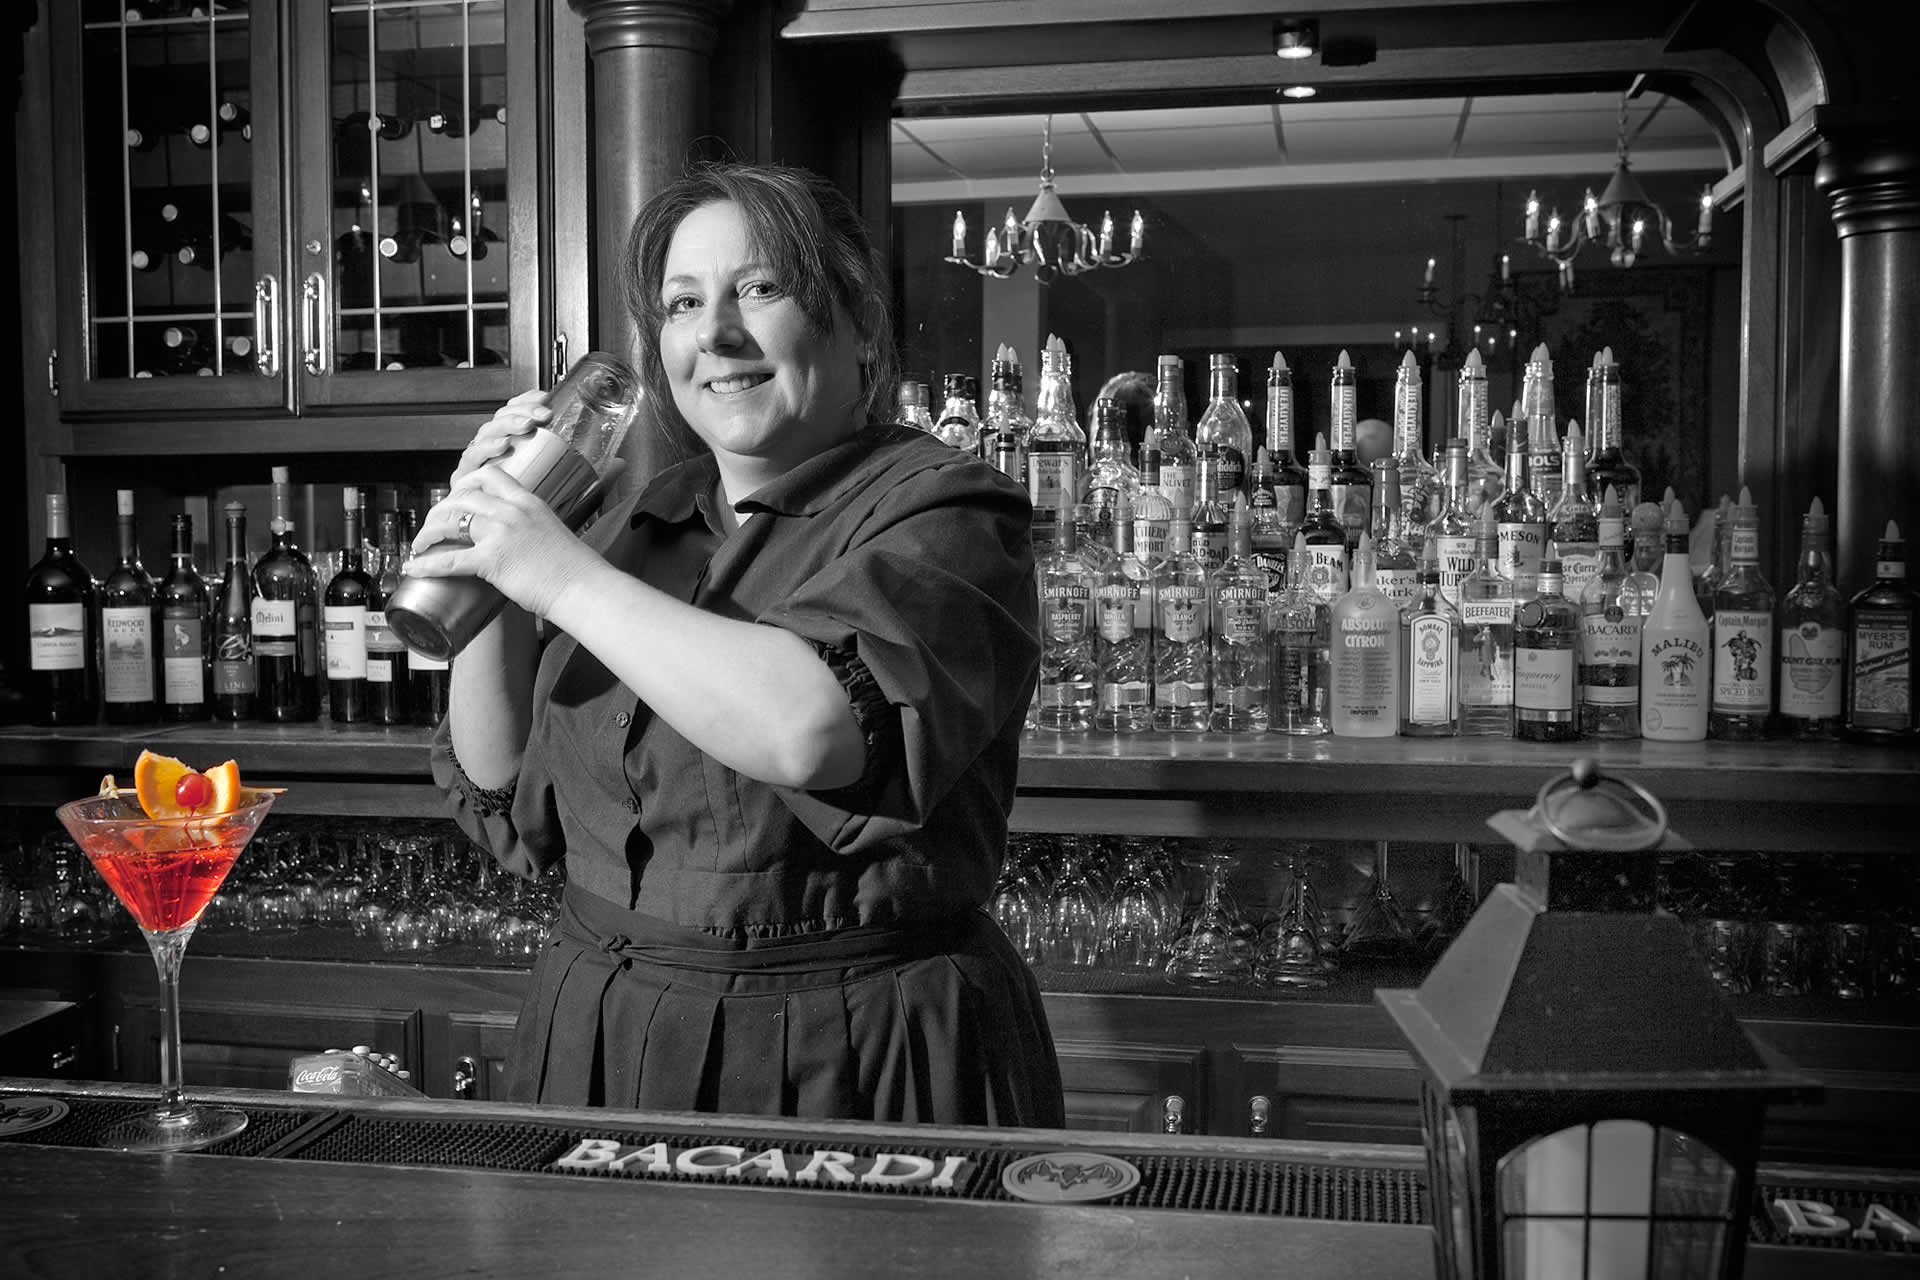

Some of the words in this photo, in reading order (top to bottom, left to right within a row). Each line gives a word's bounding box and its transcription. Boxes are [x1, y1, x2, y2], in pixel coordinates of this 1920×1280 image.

[1162, 479, 1191, 488] NLIVET
[1499, 530, 1539, 544] MESON
[1316, 552, 1344, 573] BEAM
[1447, 557, 1475, 571] WILD
[1044, 586, 1089, 599] SMIRNOFF
[1383, 587, 1414, 597] ark
[1465, 606, 1511, 618] BEEFEATER
[1341, 618, 1385, 631] ABSOLU
[1418, 623, 1444, 632] BOMBAY
[1344, 635, 1385, 648] CITRON
[1859, 631, 1906, 641] MYERS'S
[1651, 637, 1704, 658] MALIBU
[1868, 641, 1894, 649] RUM
[1781, 656, 1804, 665] OUNT
[558, 1138, 968, 1188] BACARDI
